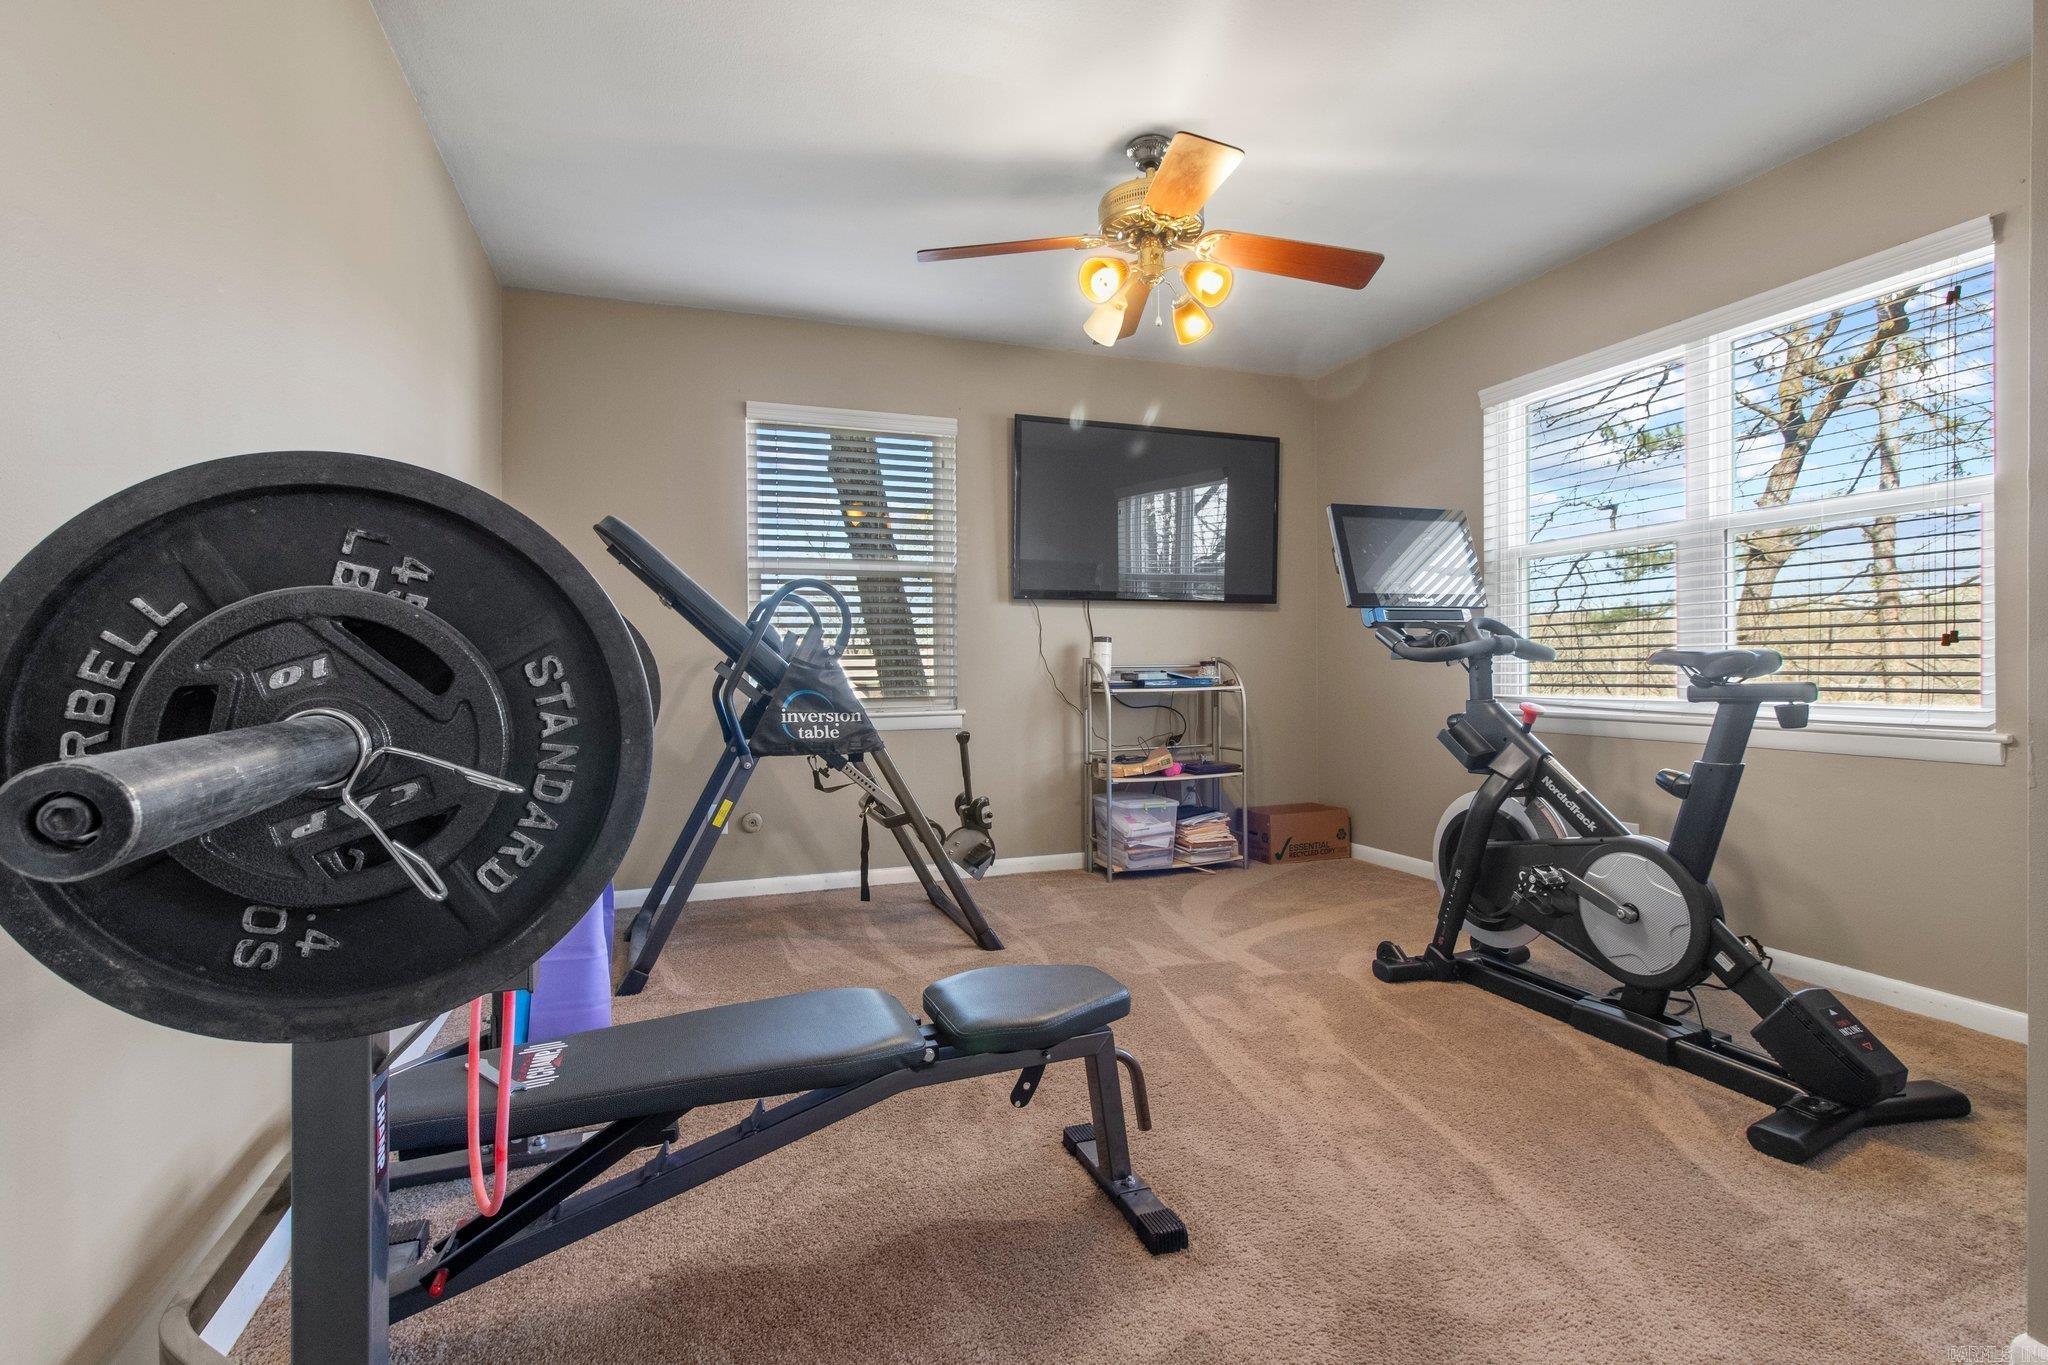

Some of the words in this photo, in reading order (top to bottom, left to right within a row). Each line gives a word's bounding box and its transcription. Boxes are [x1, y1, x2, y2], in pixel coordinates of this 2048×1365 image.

[60, 597, 188, 760] RBELL
[780, 708, 862, 724] inversion
[798, 725, 840, 739] table
[477, 655, 579, 893] STANDARD
[1541, 776, 1597, 832] NordicTrack
[1289, 841, 1331, 852] ESSENTIAL
[1289, 849, 1318, 858] RECYCLED
[526, 1048, 562, 1079] CHAMP
[376, 1094, 386, 1172] CHAMP
